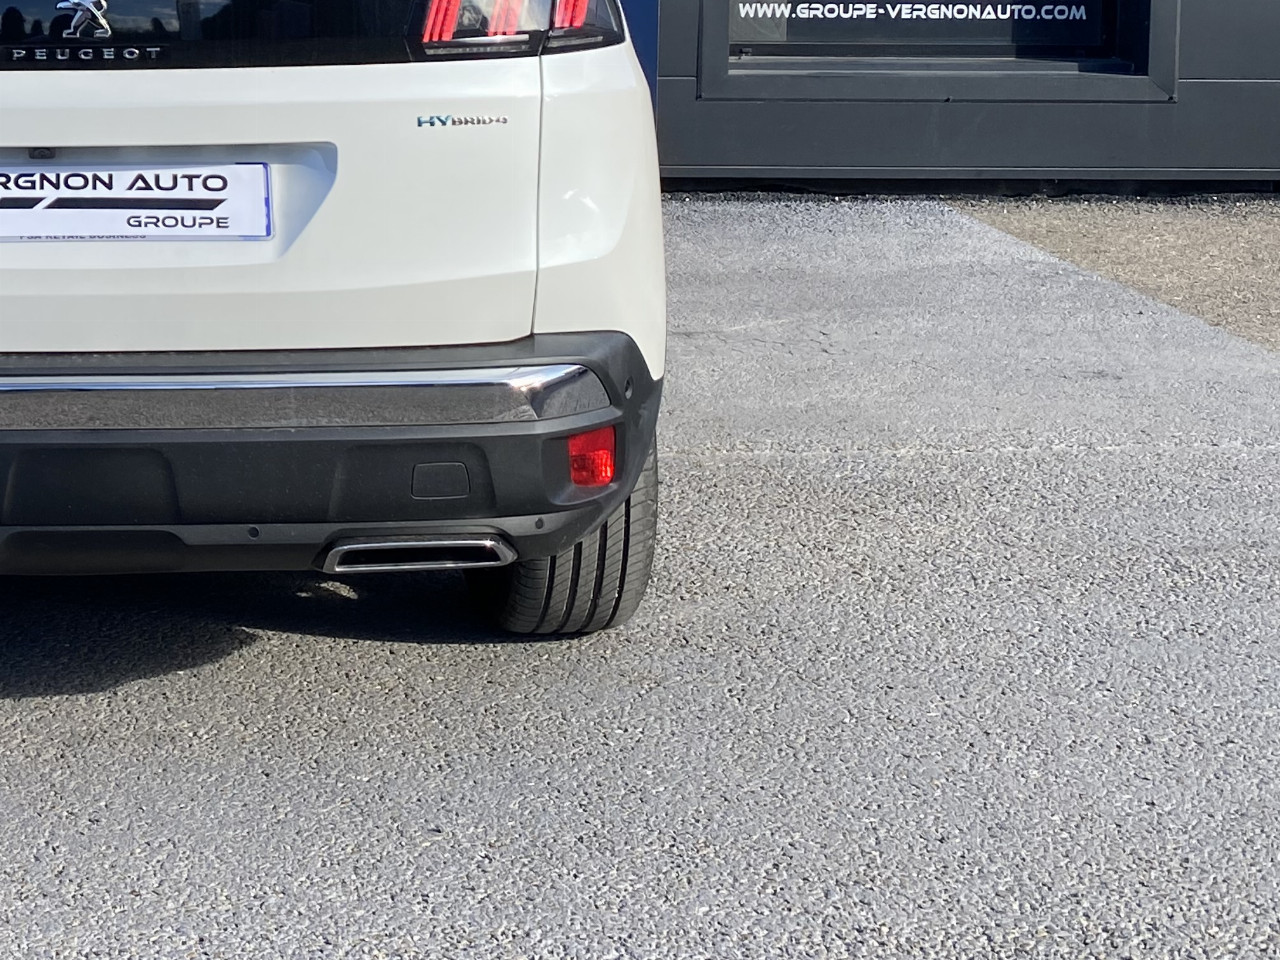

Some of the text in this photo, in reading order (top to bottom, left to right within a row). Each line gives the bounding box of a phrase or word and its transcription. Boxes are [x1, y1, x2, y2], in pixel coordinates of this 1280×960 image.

[738, 3, 1087, 20] WWW.GROUPE-VERGNONAUTO.COM
[12, 47, 162, 61] PEUGEOT
[126, 173, 229, 192] AUTO
[126, 216, 230, 229] GROUPE
